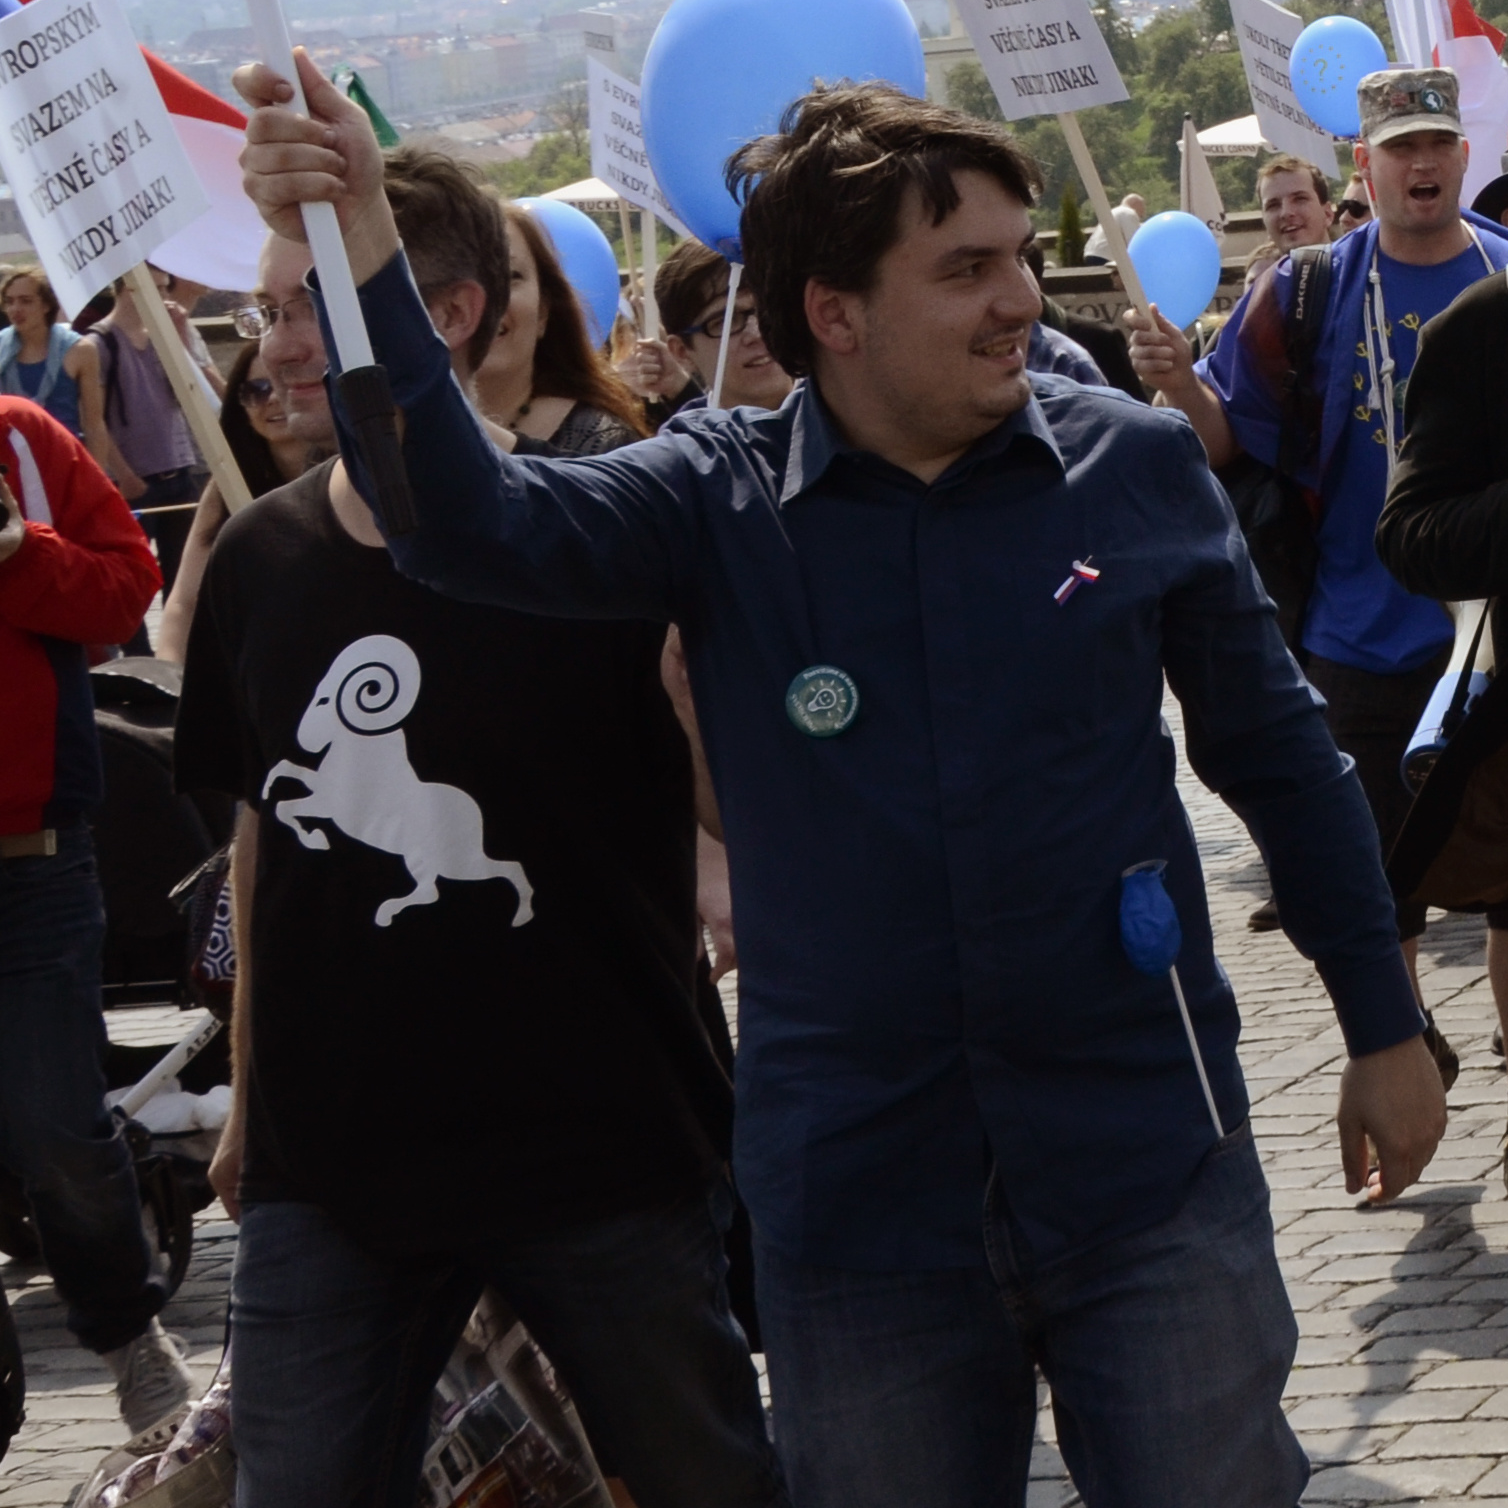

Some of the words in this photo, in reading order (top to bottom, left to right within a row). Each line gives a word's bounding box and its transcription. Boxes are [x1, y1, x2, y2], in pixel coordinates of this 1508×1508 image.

[1029, 22, 1066, 50] ČASY
[1067, 21, 1081, 42] A
[88, 67, 119, 108] NA
[1048, 63, 1099, 95] JINAK!
[612, 85, 641, 110] EVR
[136, 117, 153, 146] A
